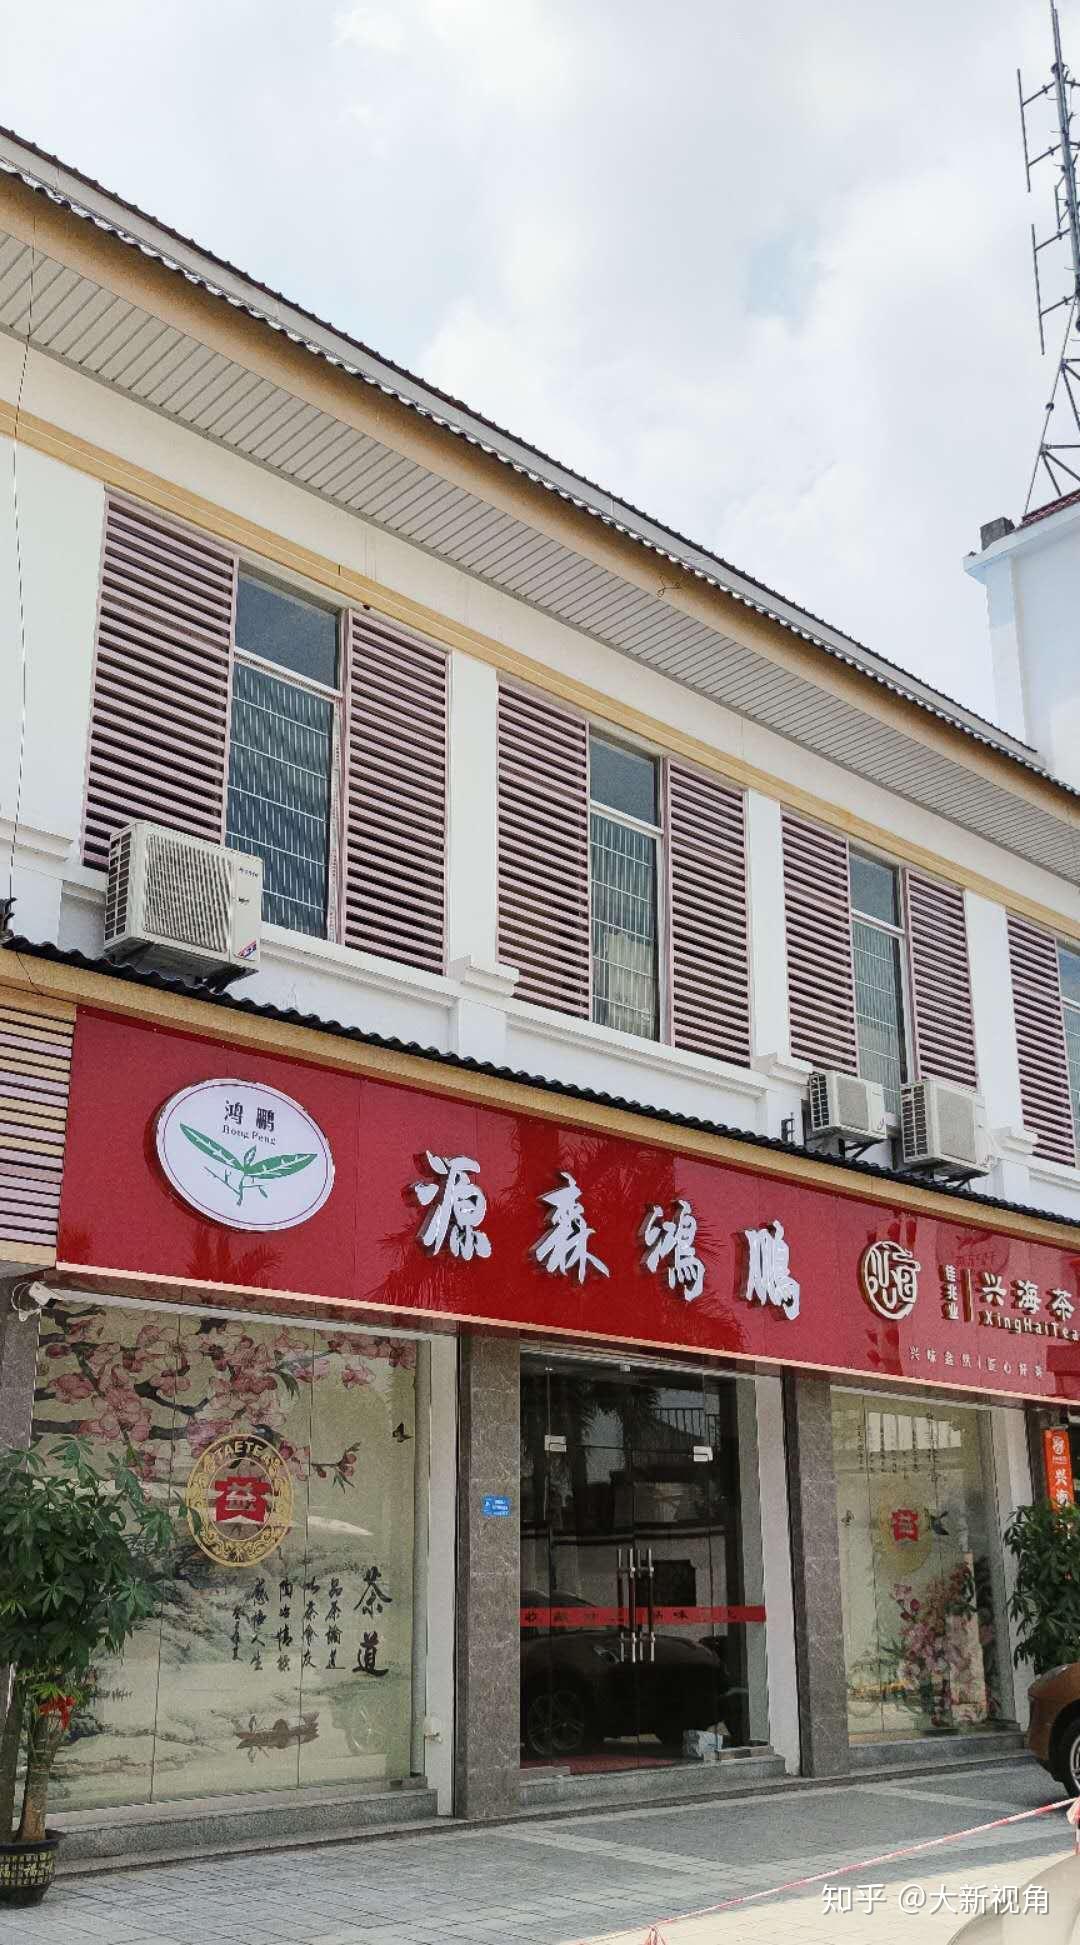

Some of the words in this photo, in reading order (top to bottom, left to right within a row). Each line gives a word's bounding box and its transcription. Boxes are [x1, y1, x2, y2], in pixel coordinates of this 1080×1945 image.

[223, 1125, 249, 1139] Hong
[252, 1131, 276, 1145] Peng
[224, 1100, 275, 1132] 鸿鹏
[414, 1150, 800, 1320] 源森鸿鹏
[982, 1272, 1075, 1321] 兴海茶
[353, 1566, 393, 1677] 茶道
